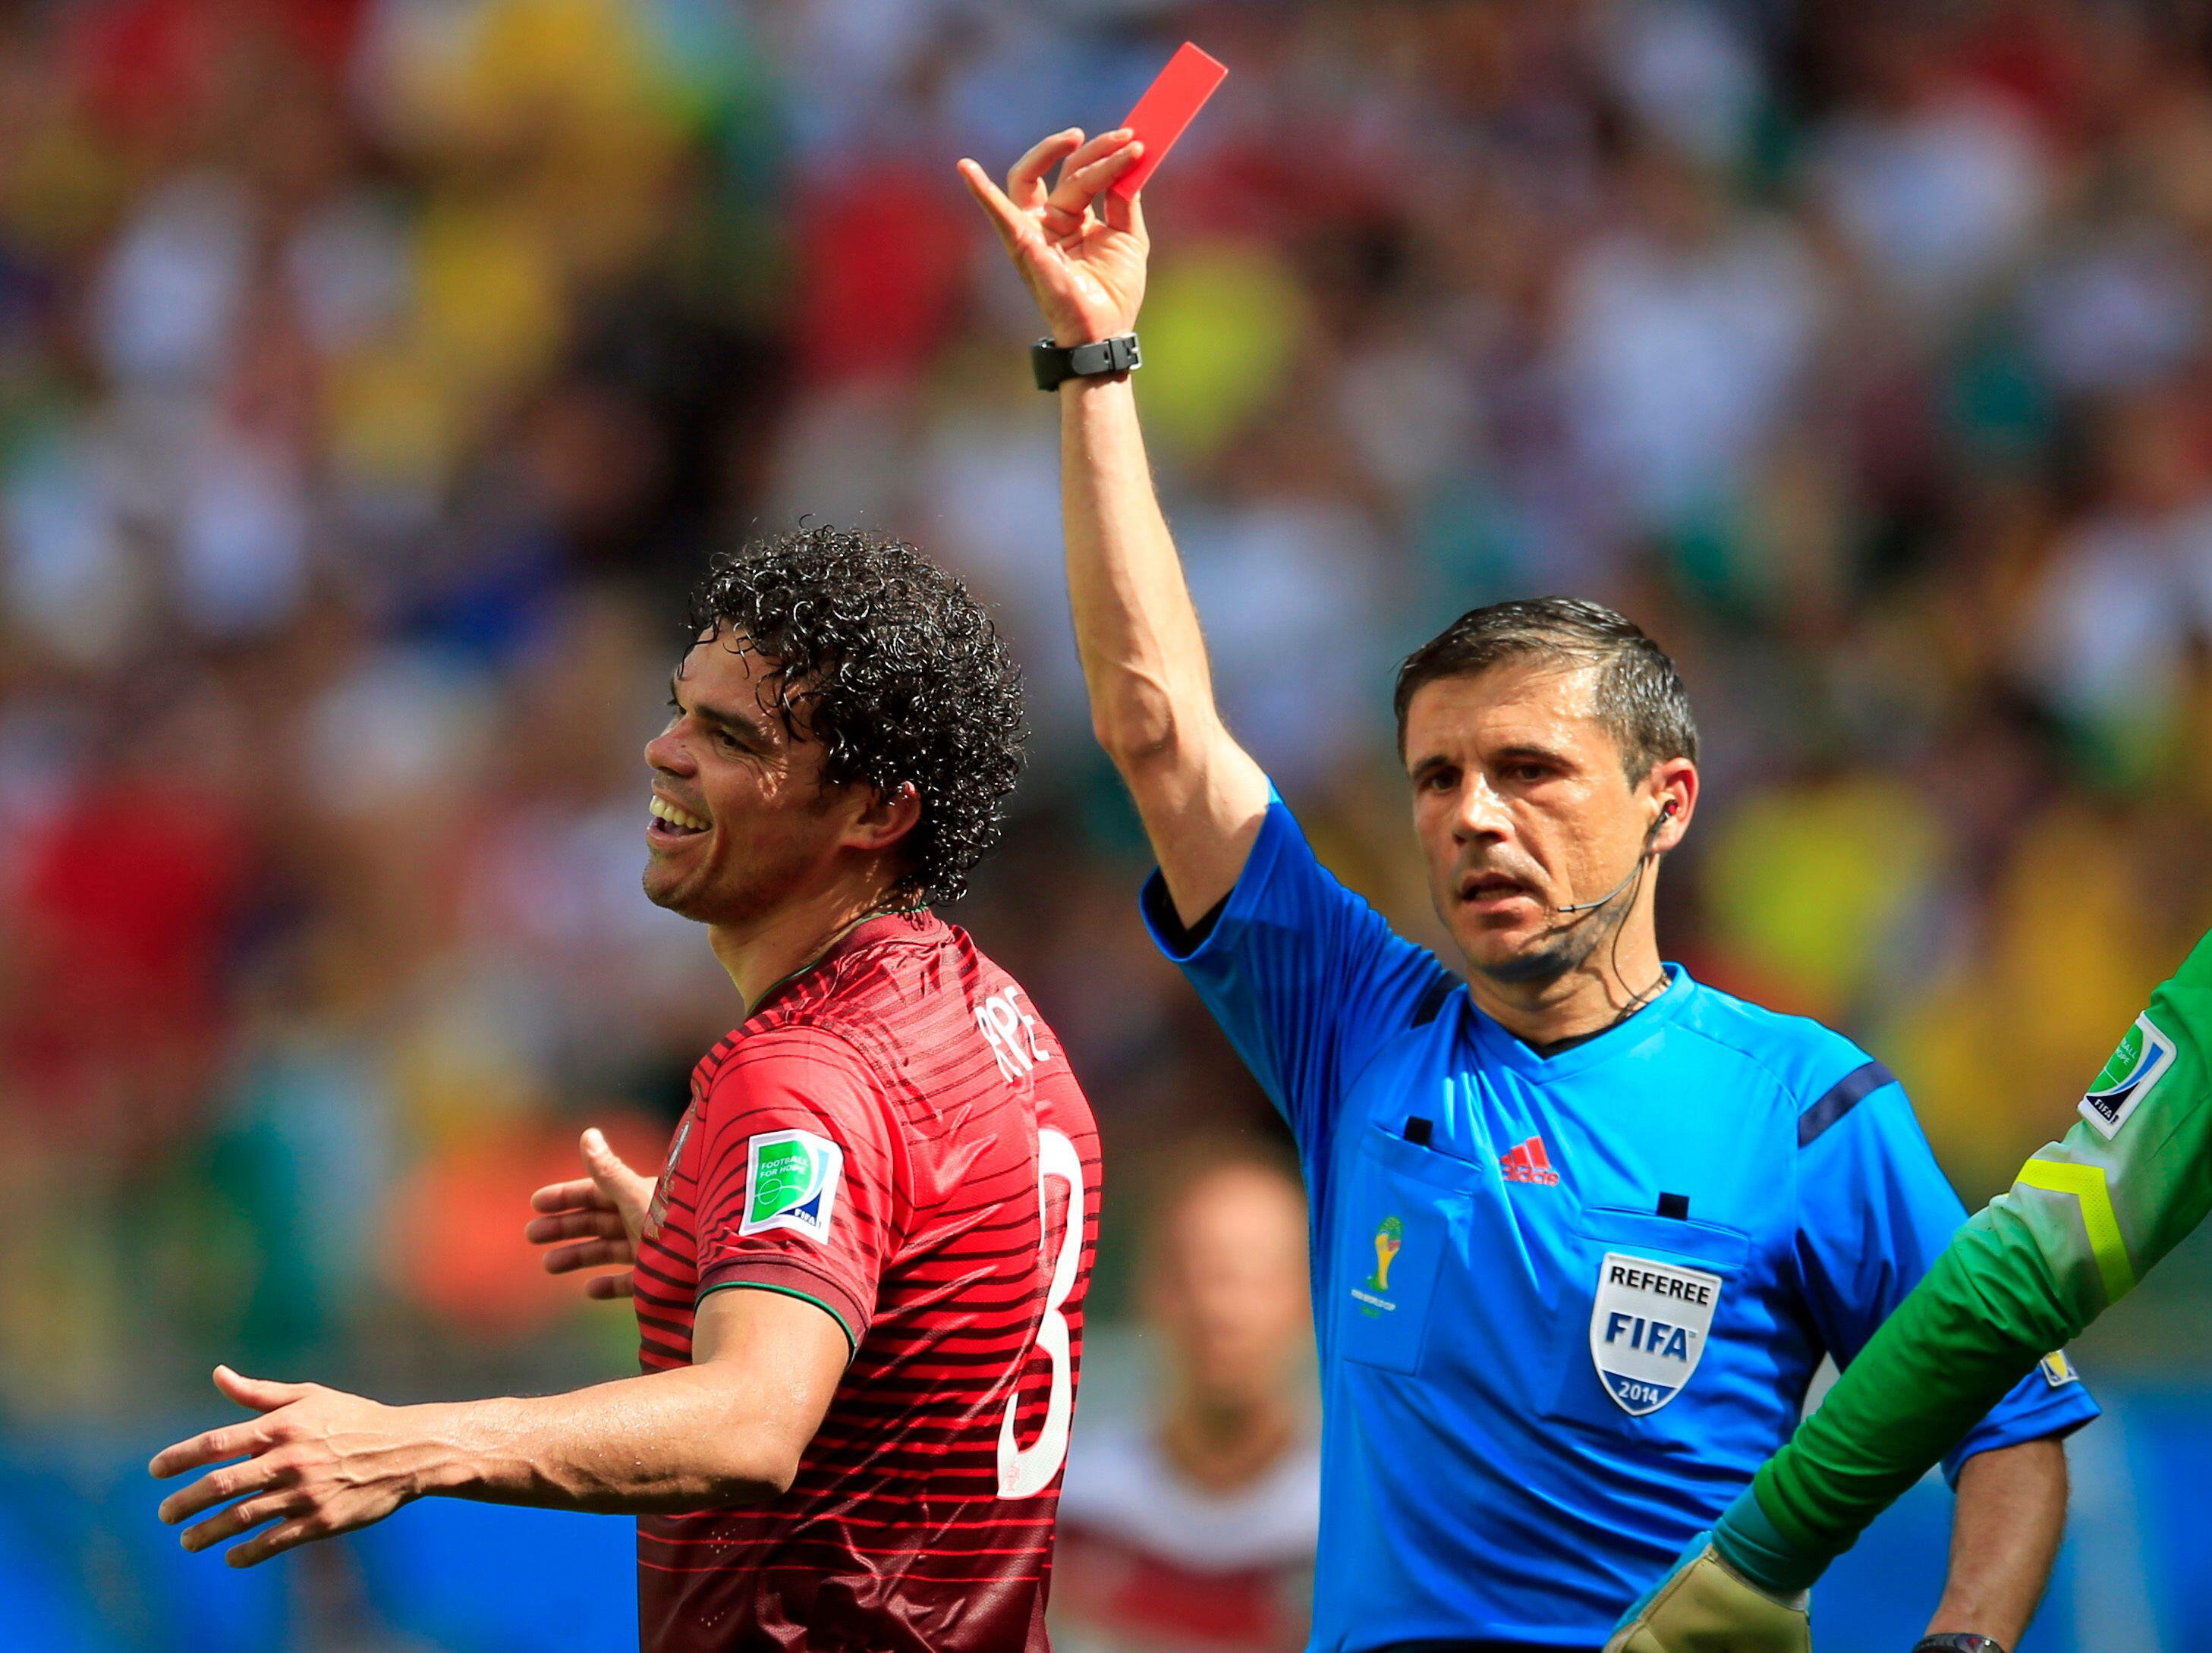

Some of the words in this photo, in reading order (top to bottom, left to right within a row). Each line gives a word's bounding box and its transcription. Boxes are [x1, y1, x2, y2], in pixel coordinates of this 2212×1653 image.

[2094, 1098, 2112, 1118] FIFA
[760, 1168, 778, 1177] FOR
[794, 1208, 816, 1227] FIFA
[1609, 1265, 1711, 1305] REFEREE
[996, 1128, 1084, 1499] 3
[1606, 1312, 1688, 1361] FIFA
[1619, 1381, 1660, 1405] 2014
